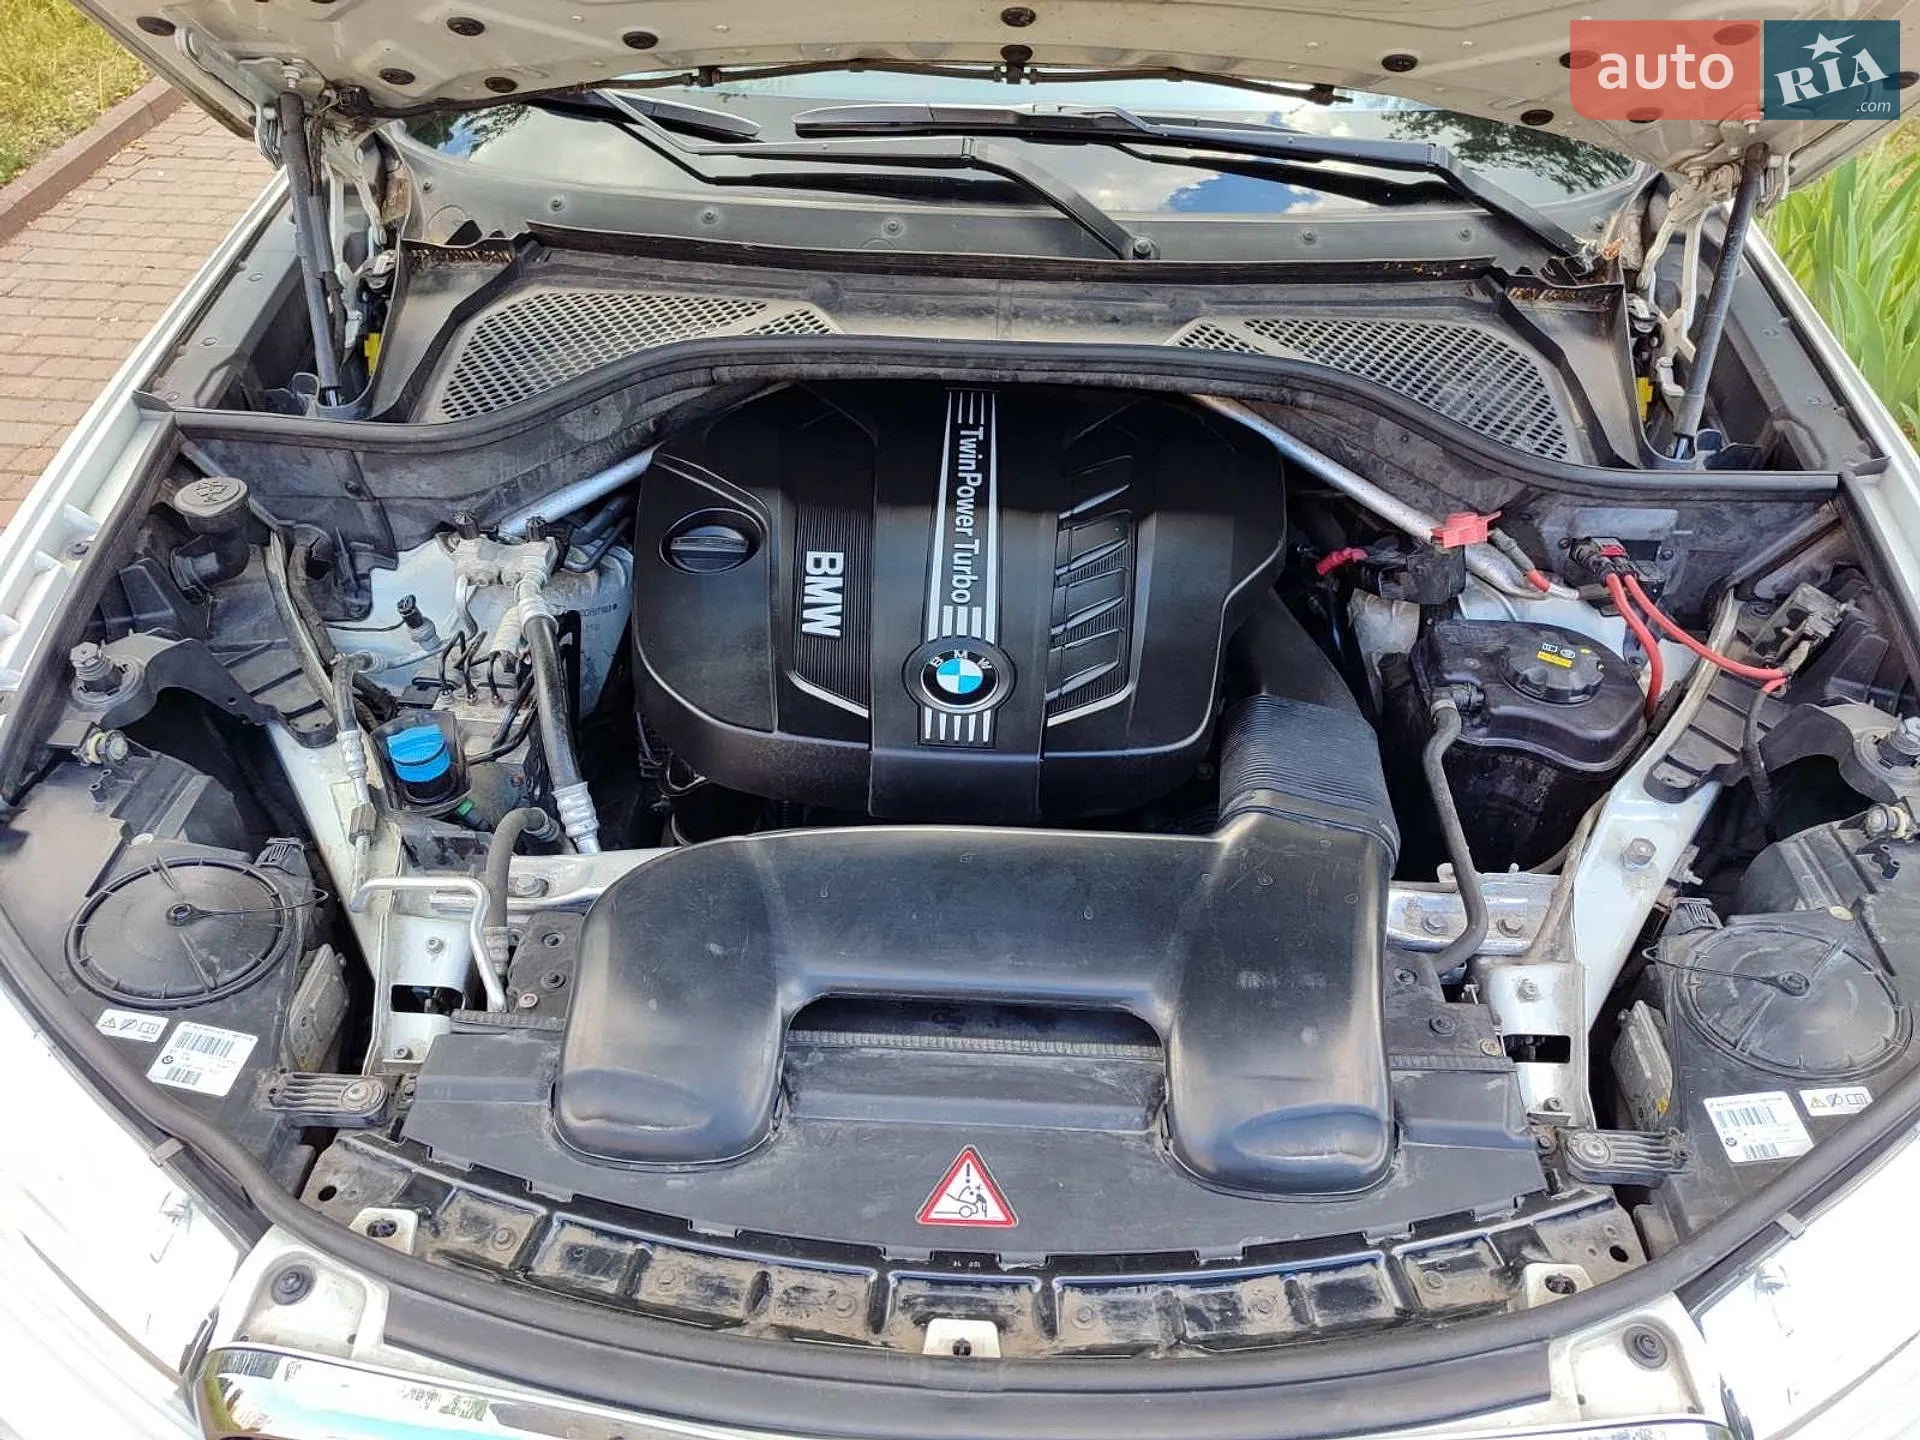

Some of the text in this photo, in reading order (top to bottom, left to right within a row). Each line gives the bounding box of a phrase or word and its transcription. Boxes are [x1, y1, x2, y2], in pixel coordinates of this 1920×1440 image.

[950, 426, 984, 604] TwinPower Turbo
[801, 551, 844, 637] BMW
[930, 649, 993, 670] BMW
